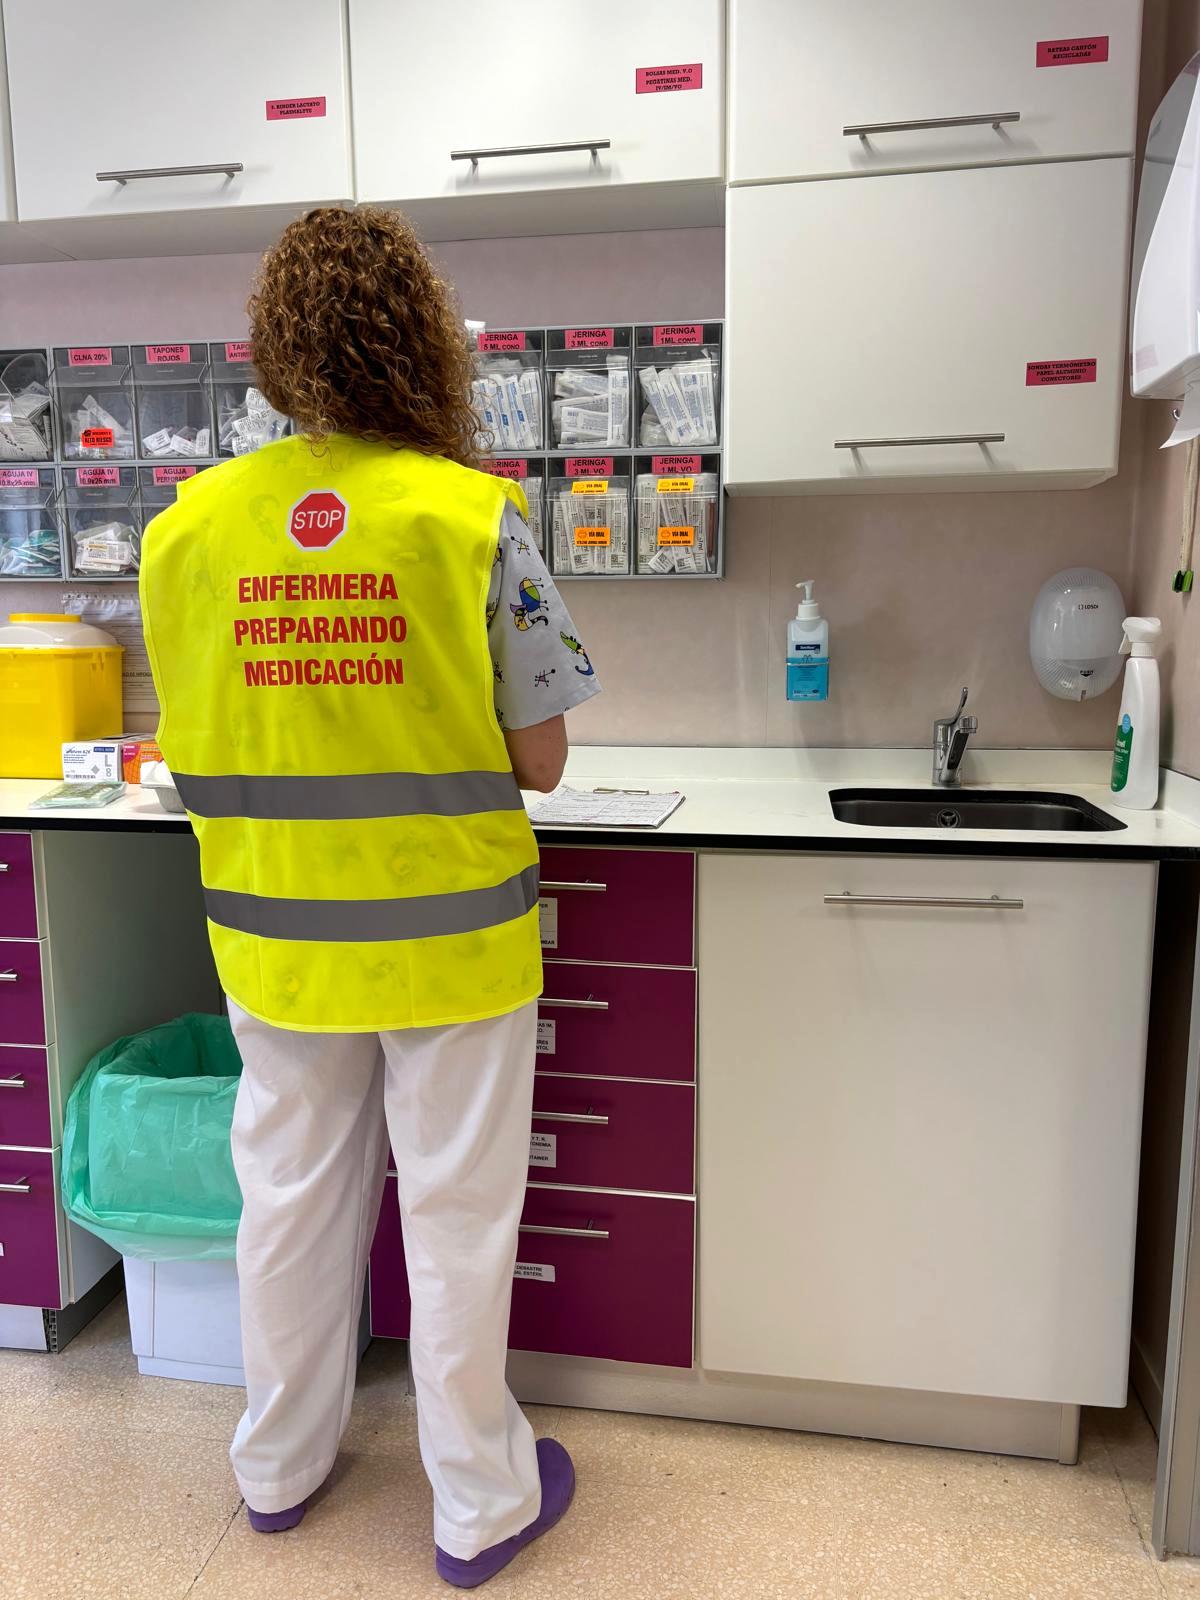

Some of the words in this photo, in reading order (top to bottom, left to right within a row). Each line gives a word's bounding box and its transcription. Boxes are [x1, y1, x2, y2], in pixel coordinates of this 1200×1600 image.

[645, 77, 676, 85] PEGATINAS
[572, 330, 606, 338] JERINGA
[661, 327, 696, 335] JERINGA
[573, 458, 607, 467] JERINGA
[294, 510, 342, 530] STOP
[238, 573, 398, 603] ENFERMERA
[234, 615, 407, 646] PREPARANDO
[244, 652, 404, 687] MEDICACIÓN
[105, 754, 112, 767] L
[106, 768, 112, 777] 8
